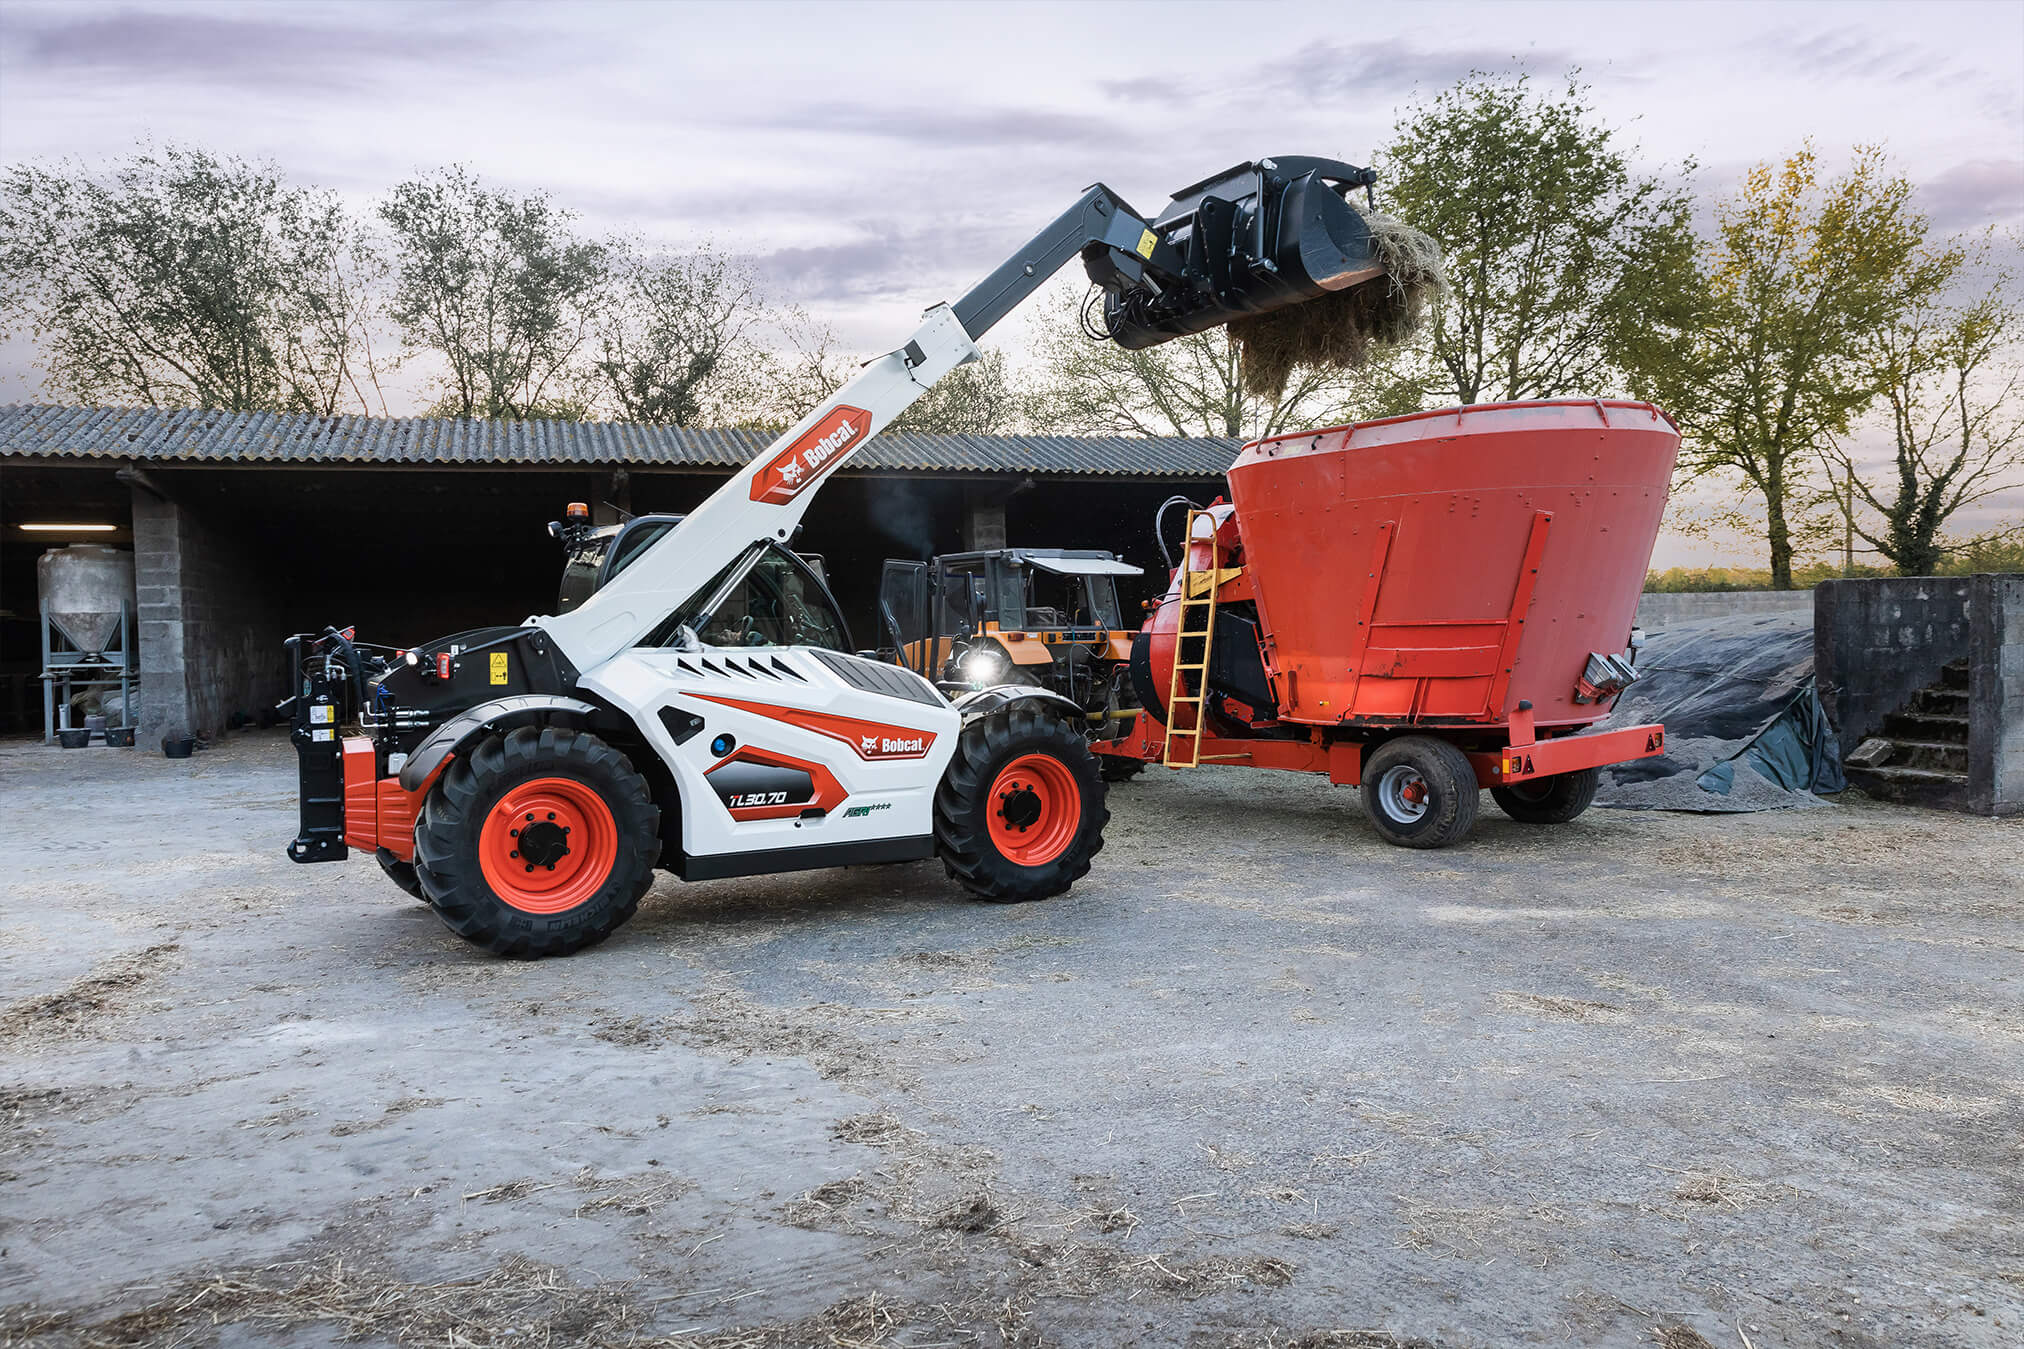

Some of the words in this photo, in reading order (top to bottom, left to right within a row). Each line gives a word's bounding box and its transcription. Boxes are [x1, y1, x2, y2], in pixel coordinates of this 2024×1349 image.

[803, 419, 856, 469] Bobcat
[882, 738, 923, 752] Bobcat
[730, 791, 788, 807] TL30.70
